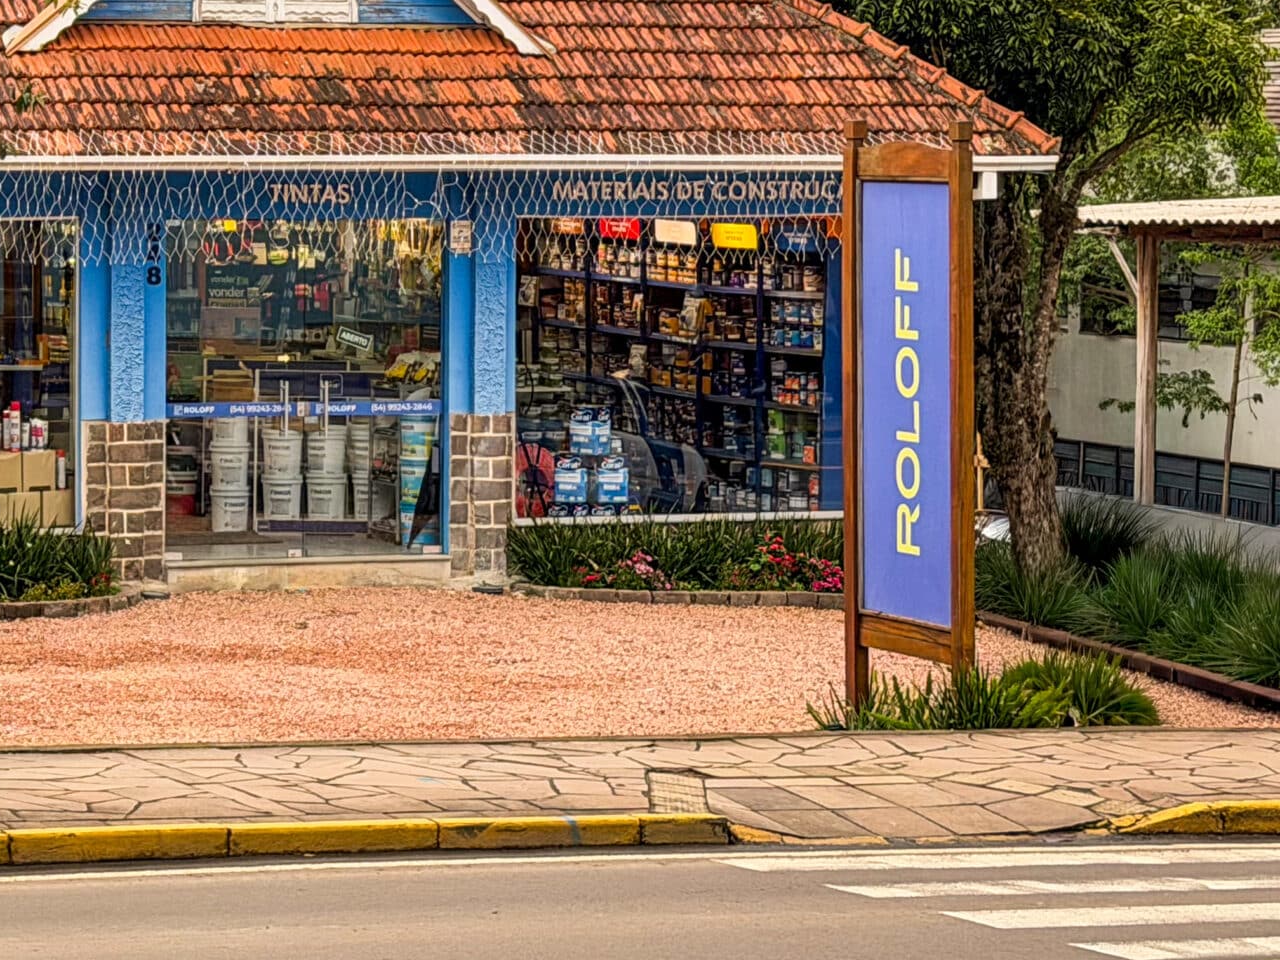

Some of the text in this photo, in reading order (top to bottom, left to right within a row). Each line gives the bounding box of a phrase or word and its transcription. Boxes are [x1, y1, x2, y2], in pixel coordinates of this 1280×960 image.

[270, 183, 351, 204] TINTAS
[553, 180, 670, 201] MATERIAIS
[676, 180, 705, 201] DE
[183, 406, 216, 414] ROLOFF
[894, 247, 921, 557] ROLOFF
